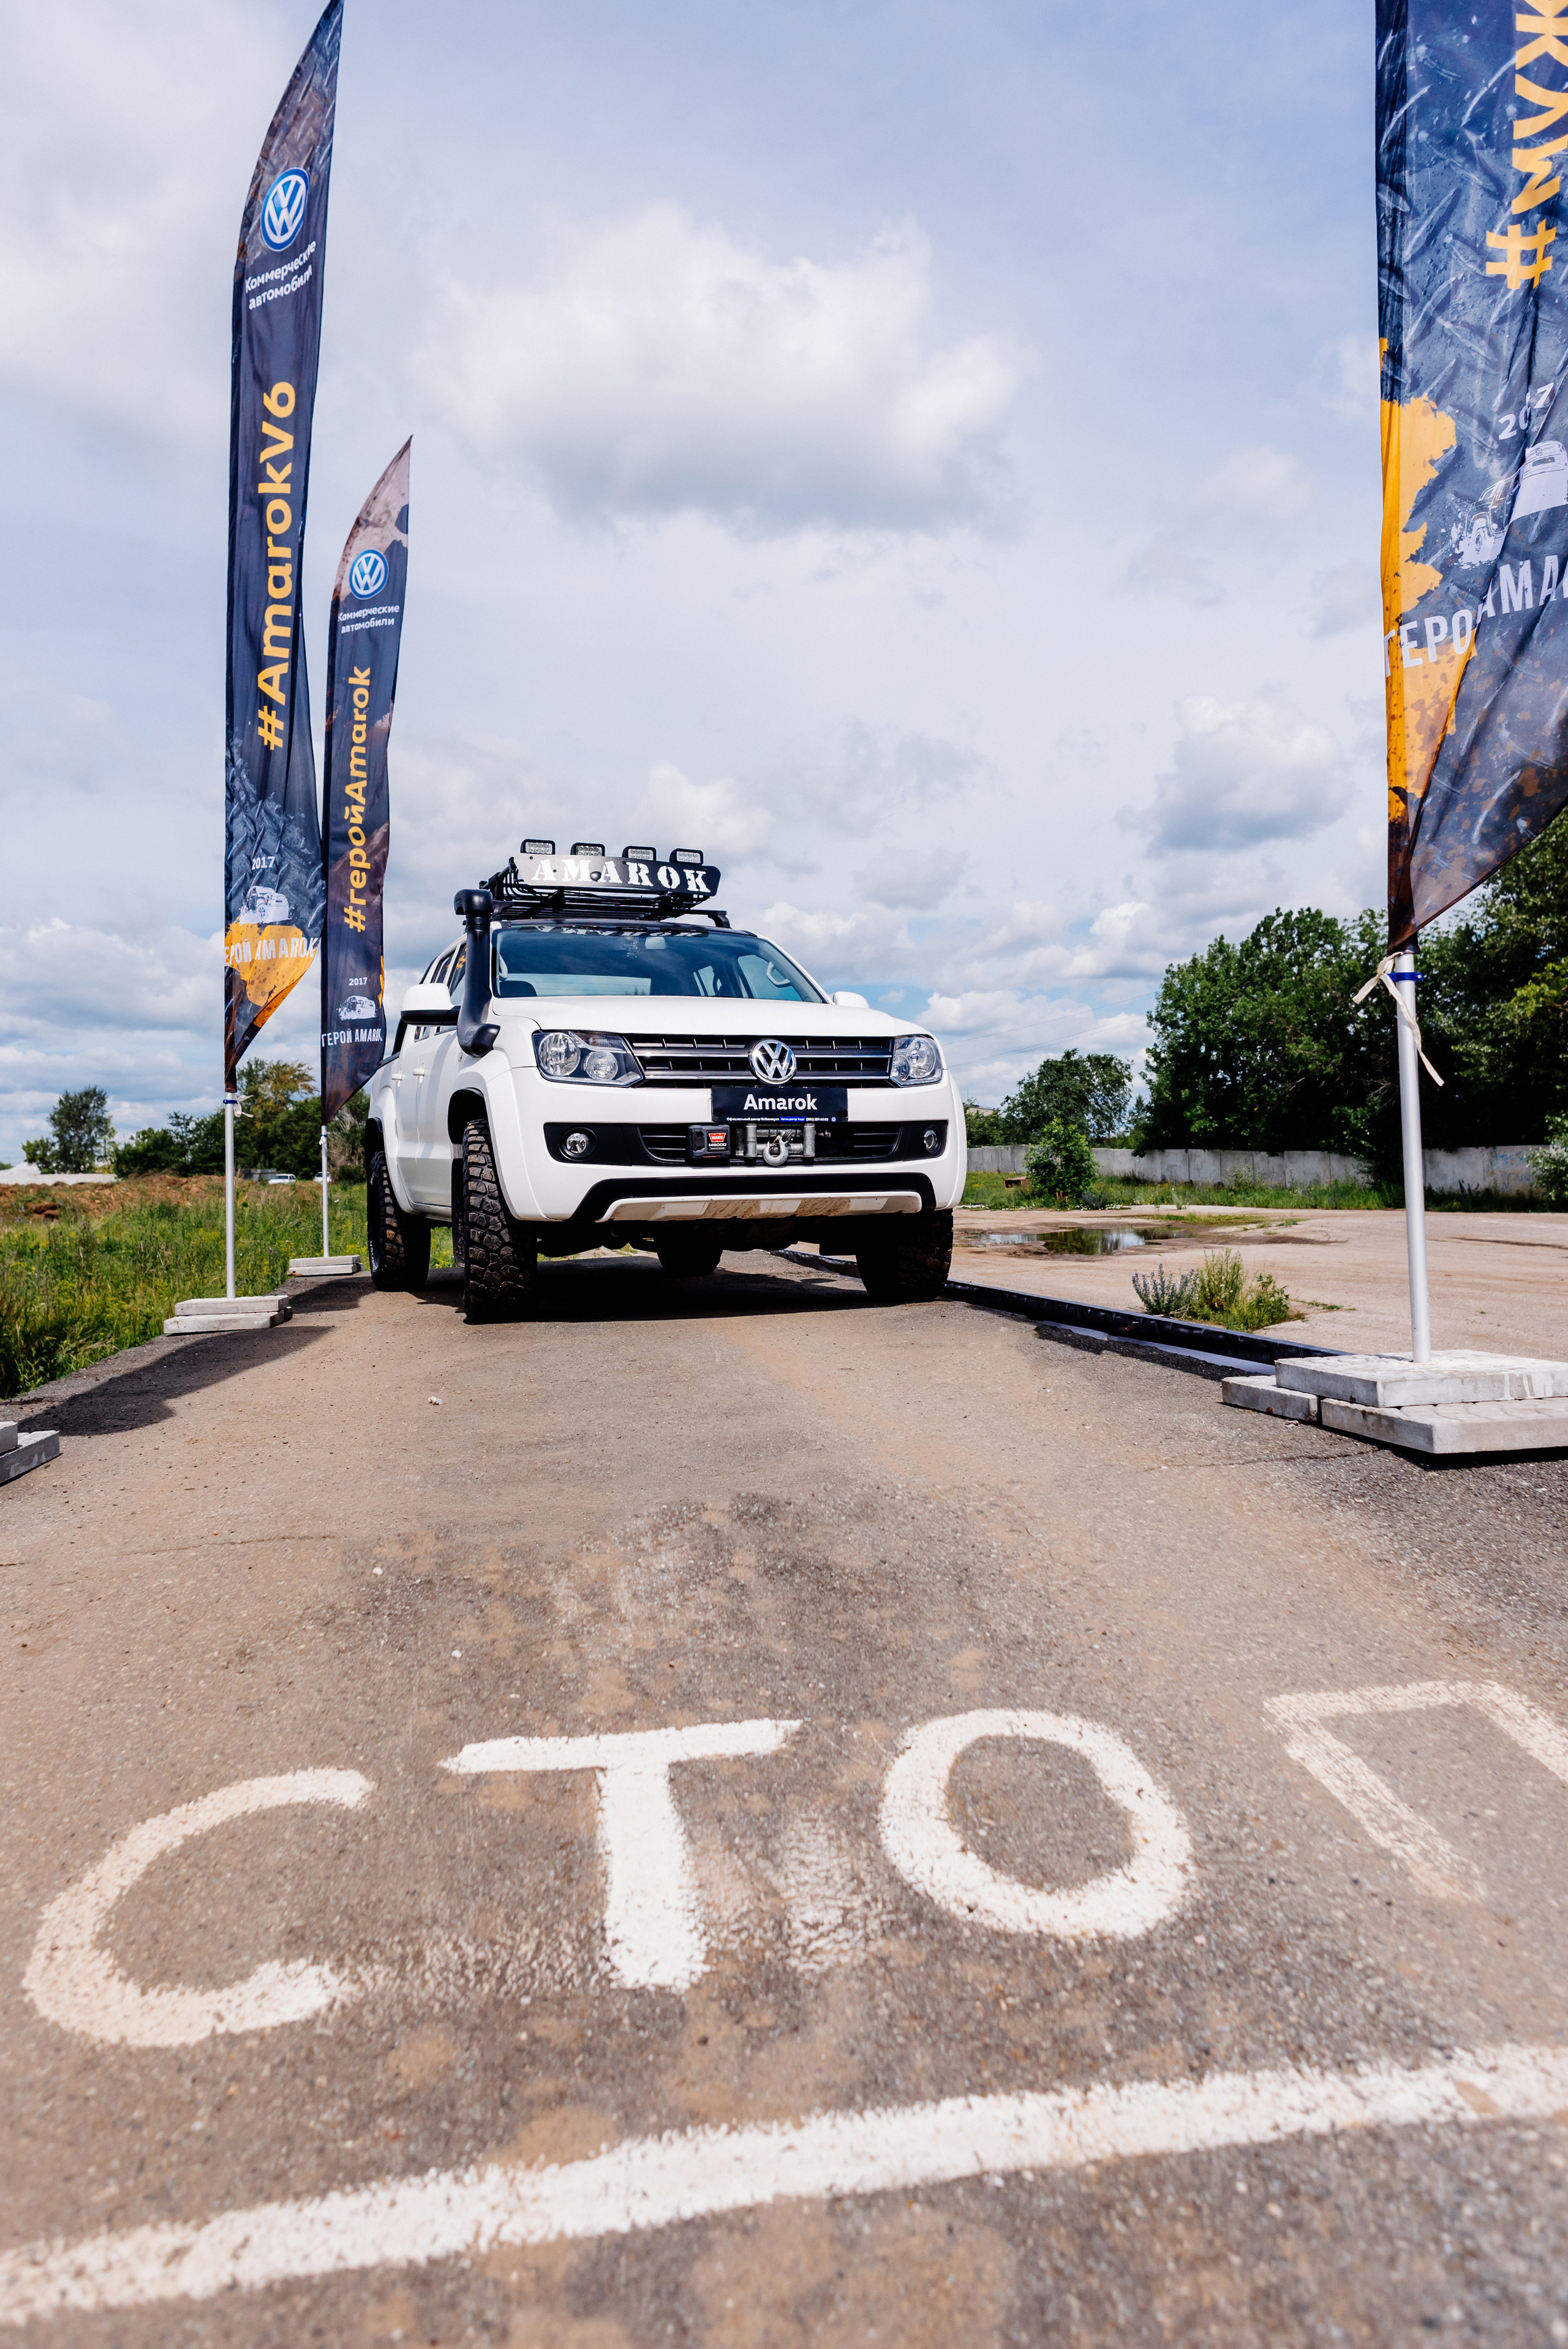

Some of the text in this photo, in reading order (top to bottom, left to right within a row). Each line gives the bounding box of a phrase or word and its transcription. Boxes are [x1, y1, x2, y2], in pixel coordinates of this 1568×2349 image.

[245, 241, 316, 294] Коммерческие
[249, 265, 312, 310] автомобили
[258, 382, 296, 751] #AmarokV6
[337, 604, 400, 622] Коммерческие
[341, 616, 395, 634] автомобили
[1384, 554, 1568, 678] ГЕРО AMA
[344, 666, 372, 932] #геройAmarok
[252, 856, 276, 871] 2017
[531, 858, 711, 893] AMAROK
[349, 977, 368, 986] 2017
[321, 1028, 352, 1048] ГЕРОЙ
[744, 1094, 818, 1110] Amarok
[21, 1680, 1568, 2048] СТОП
